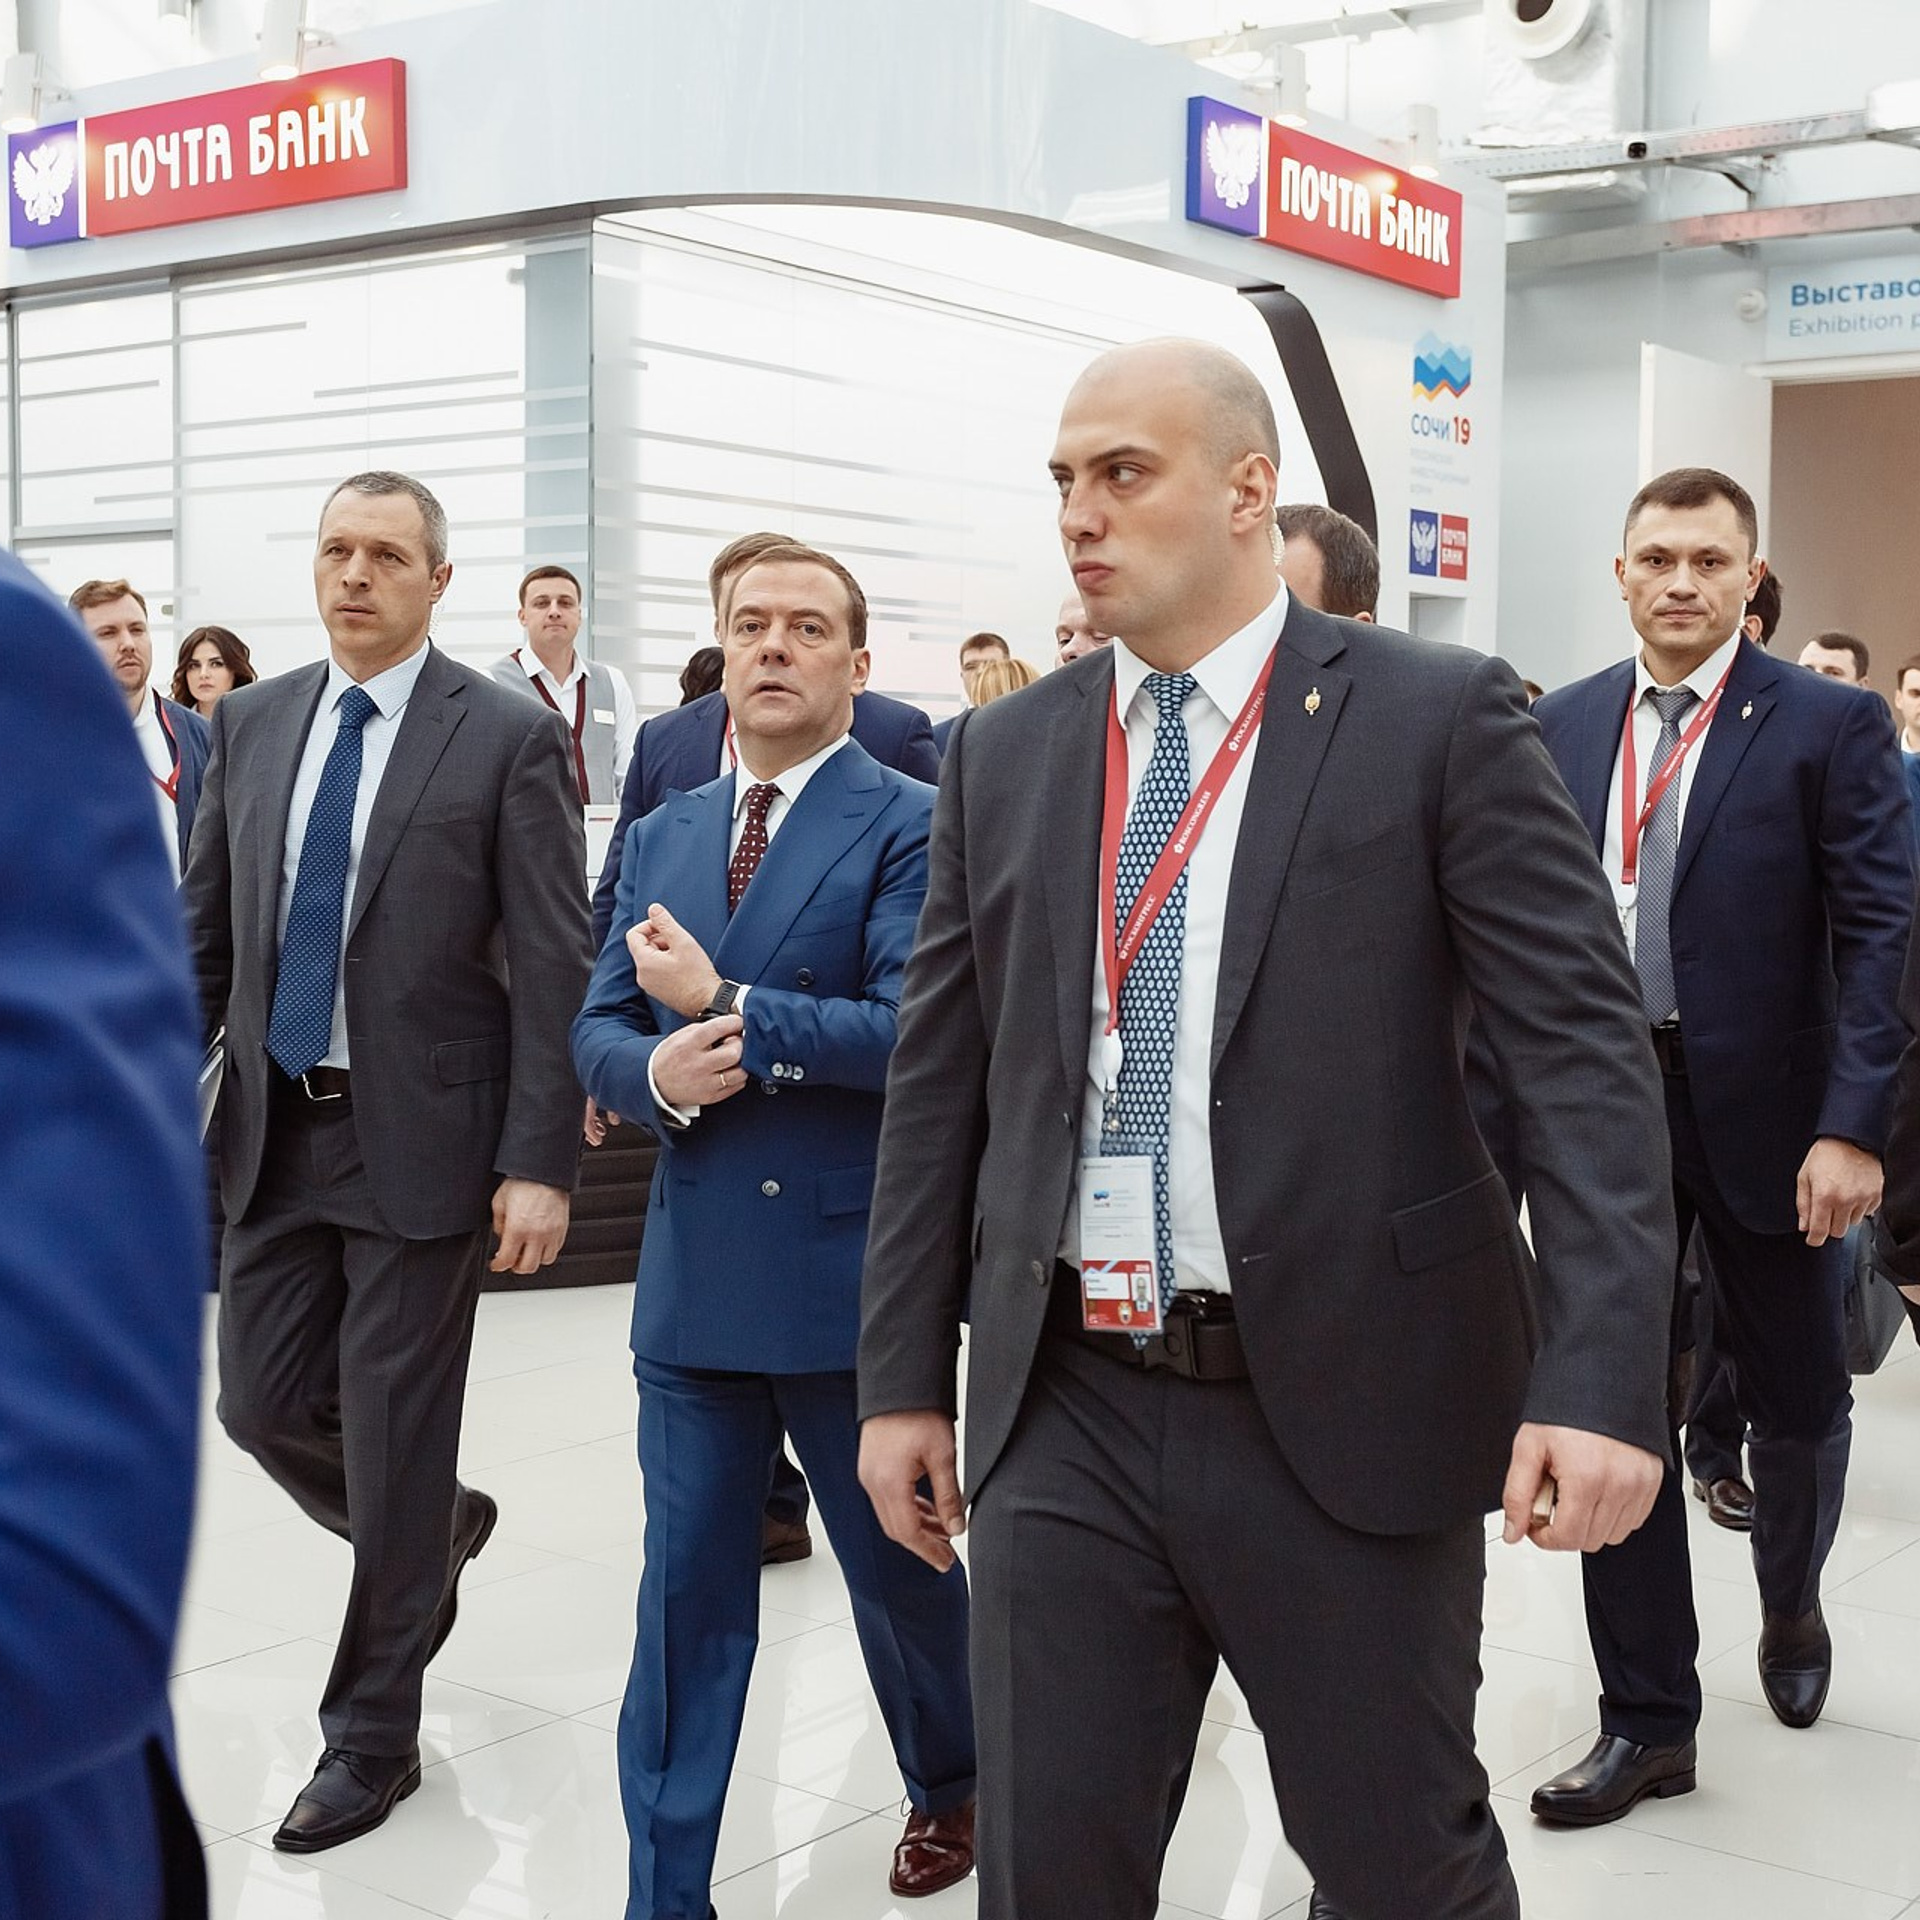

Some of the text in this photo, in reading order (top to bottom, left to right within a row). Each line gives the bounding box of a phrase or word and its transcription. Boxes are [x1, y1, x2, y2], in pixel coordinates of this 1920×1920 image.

[105, 96, 370, 201] ПОЧТА БАНК
[1280, 156, 1450, 266] ПОЧТА БАНК
[1791, 279, 1920, 307] Выставо
[1789, 314, 1902, 337] Exhibition
[1411, 413, 1471, 445] СОЧИ 19
